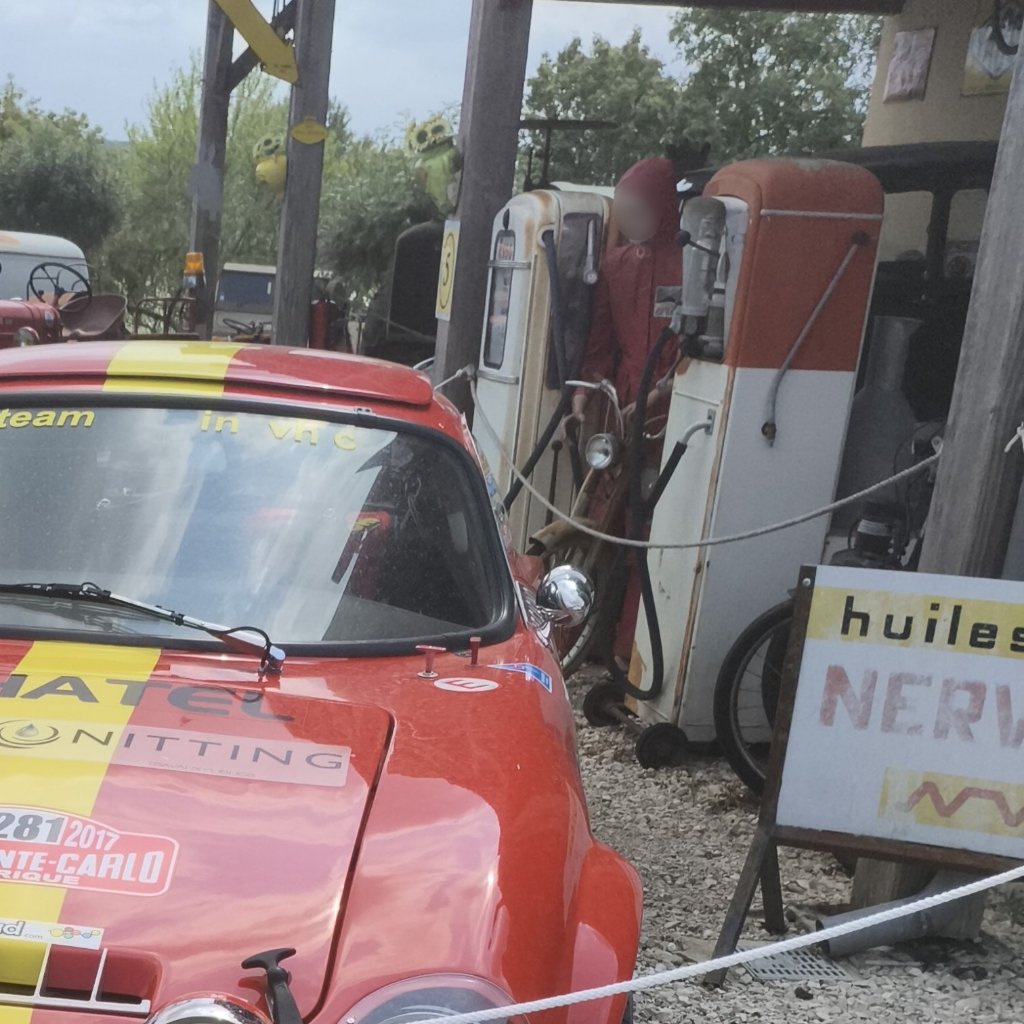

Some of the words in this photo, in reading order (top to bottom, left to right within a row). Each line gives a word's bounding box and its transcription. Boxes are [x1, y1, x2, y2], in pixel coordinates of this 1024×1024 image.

[199, 410, 239, 433] in
[71, 728, 345, 770] NITTING
[64, 819, 120, 851] 2017
